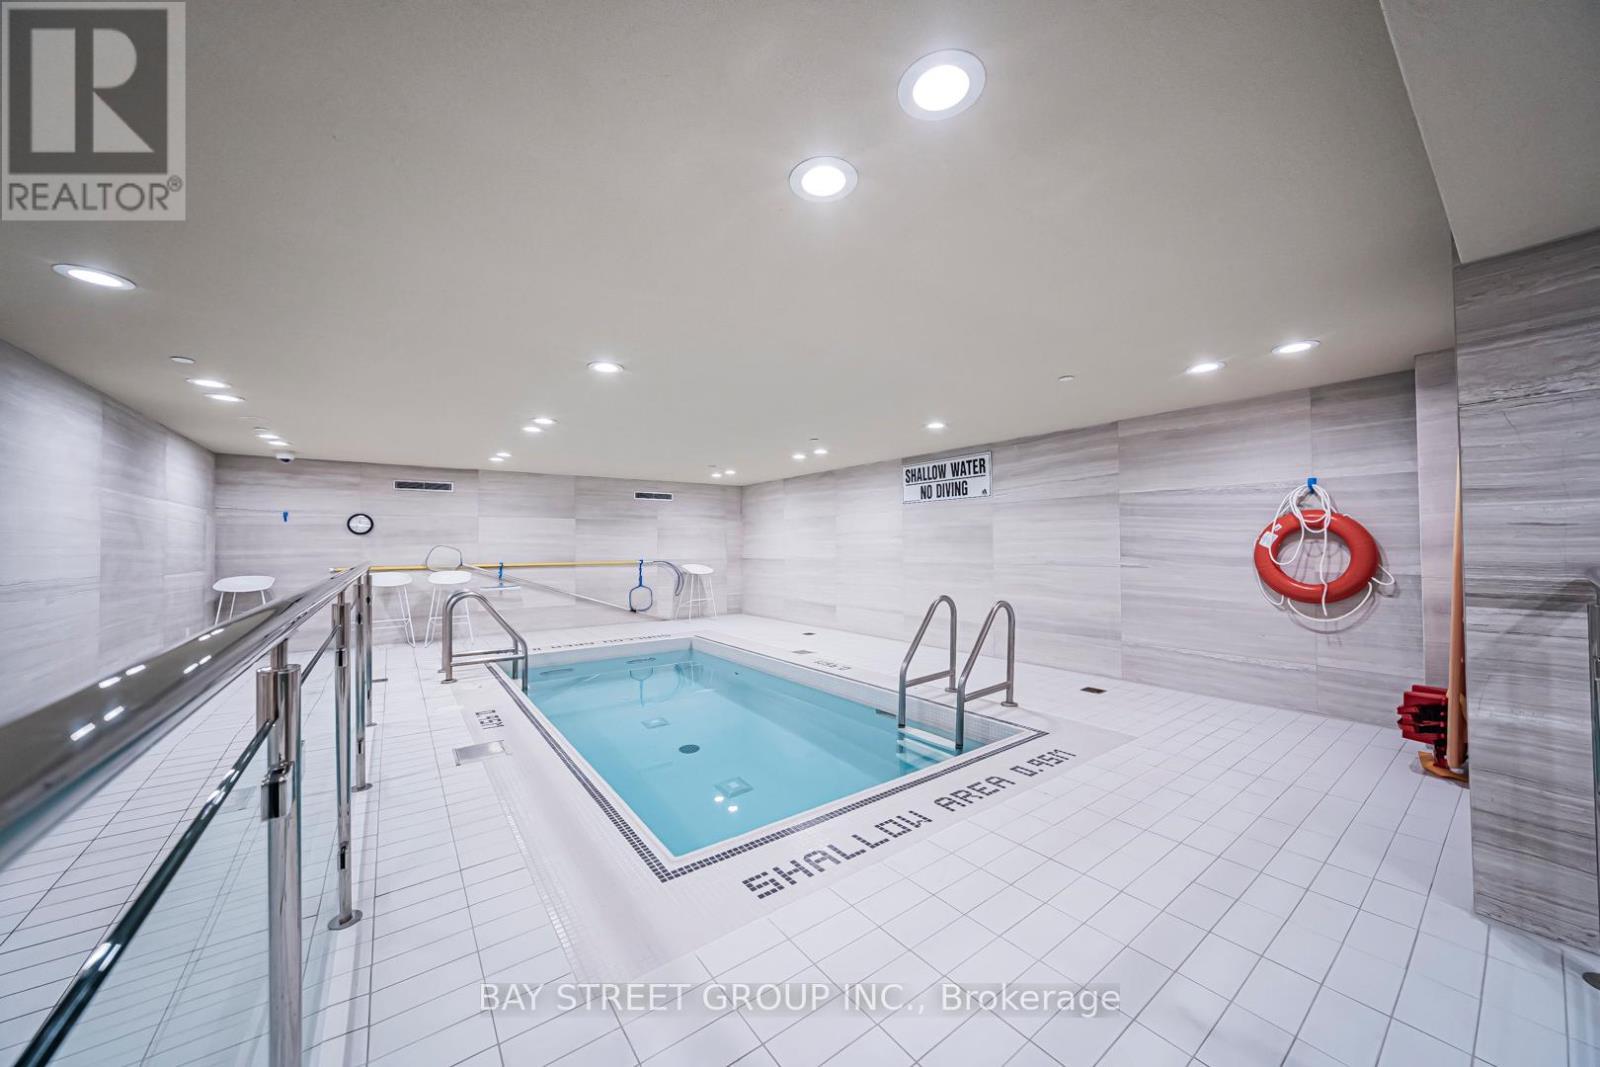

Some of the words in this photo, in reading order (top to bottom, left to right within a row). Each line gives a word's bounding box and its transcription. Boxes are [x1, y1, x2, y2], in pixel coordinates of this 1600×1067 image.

[905, 464, 946, 483] SHALLOW
[950, 458, 986, 477] WATER
[920, 485, 932, 499] NO
[936, 481, 968, 498] DIVING
[742, 810, 933, 900] SHALLOW
[934, 776, 1017, 812] AREA
